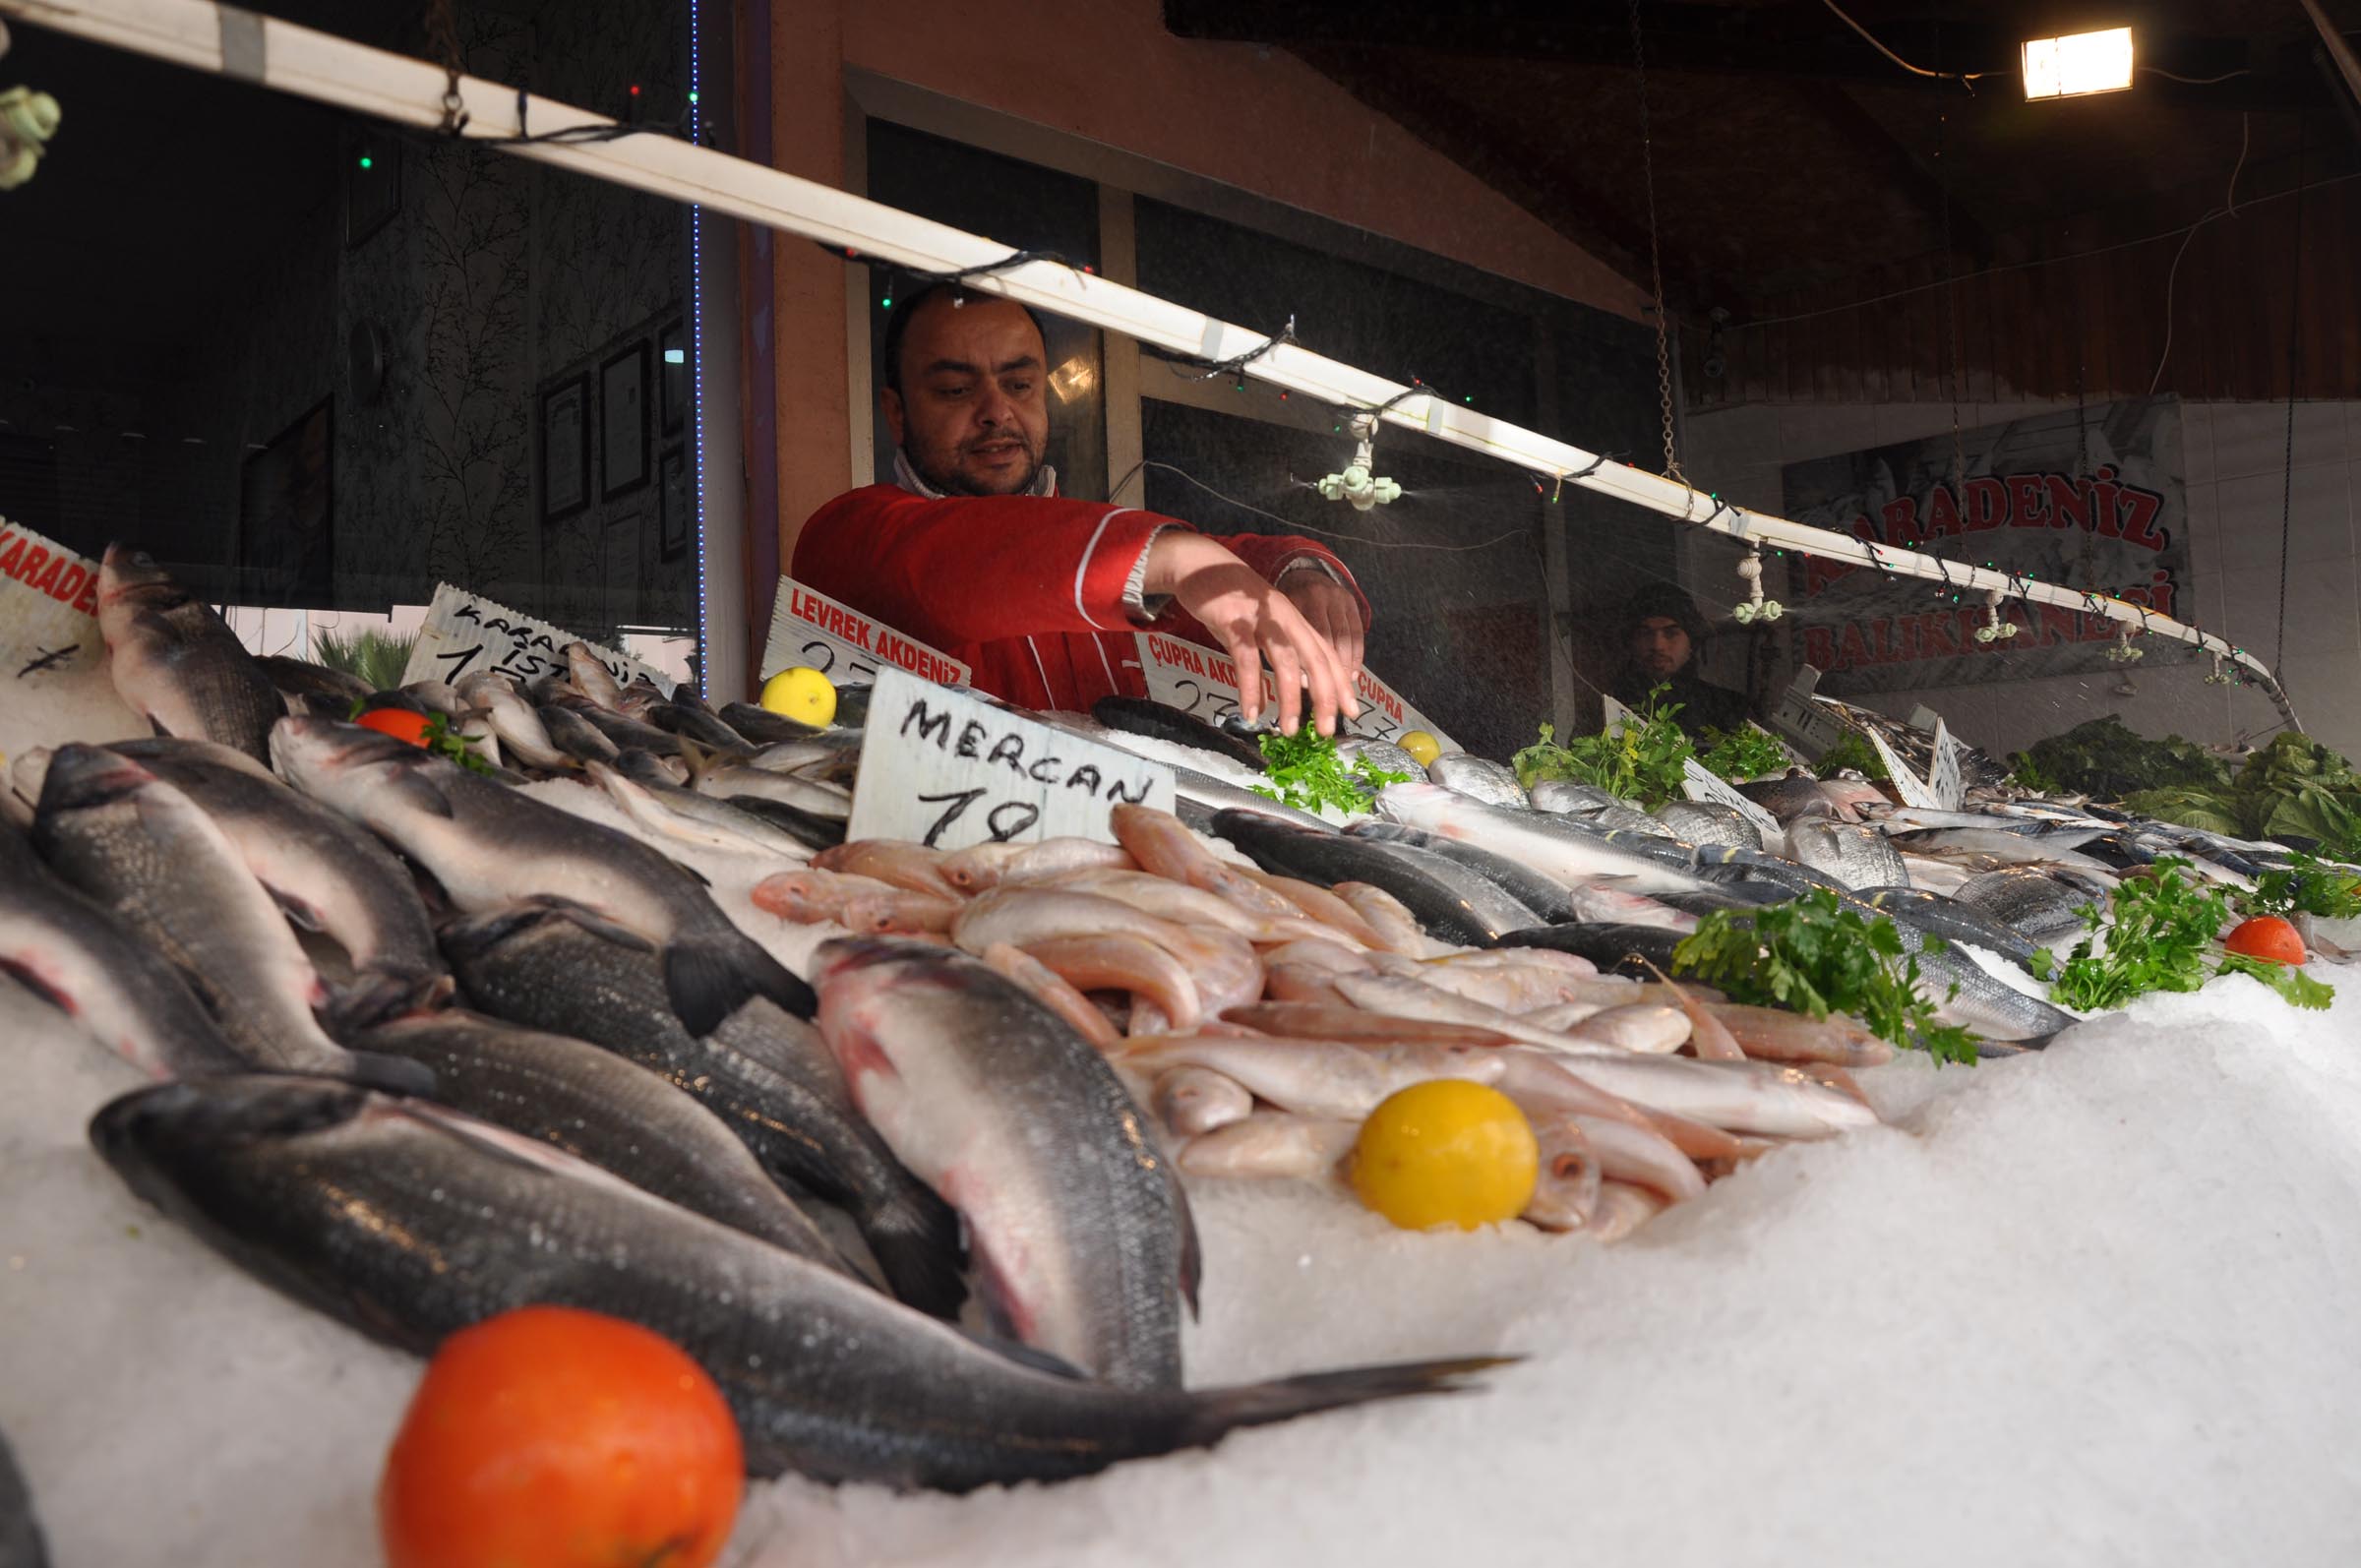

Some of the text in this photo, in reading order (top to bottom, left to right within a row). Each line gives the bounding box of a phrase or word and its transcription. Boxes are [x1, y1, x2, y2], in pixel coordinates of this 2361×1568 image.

[0, 530, 97, 618] ARADE
[791, 588, 871, 651] LEVREK
[1148, 634, 1206, 678] ÇUPRA
[1358, 671, 1404, 725] ÇUPRA
[900, 697, 1155, 804] MERCAN
